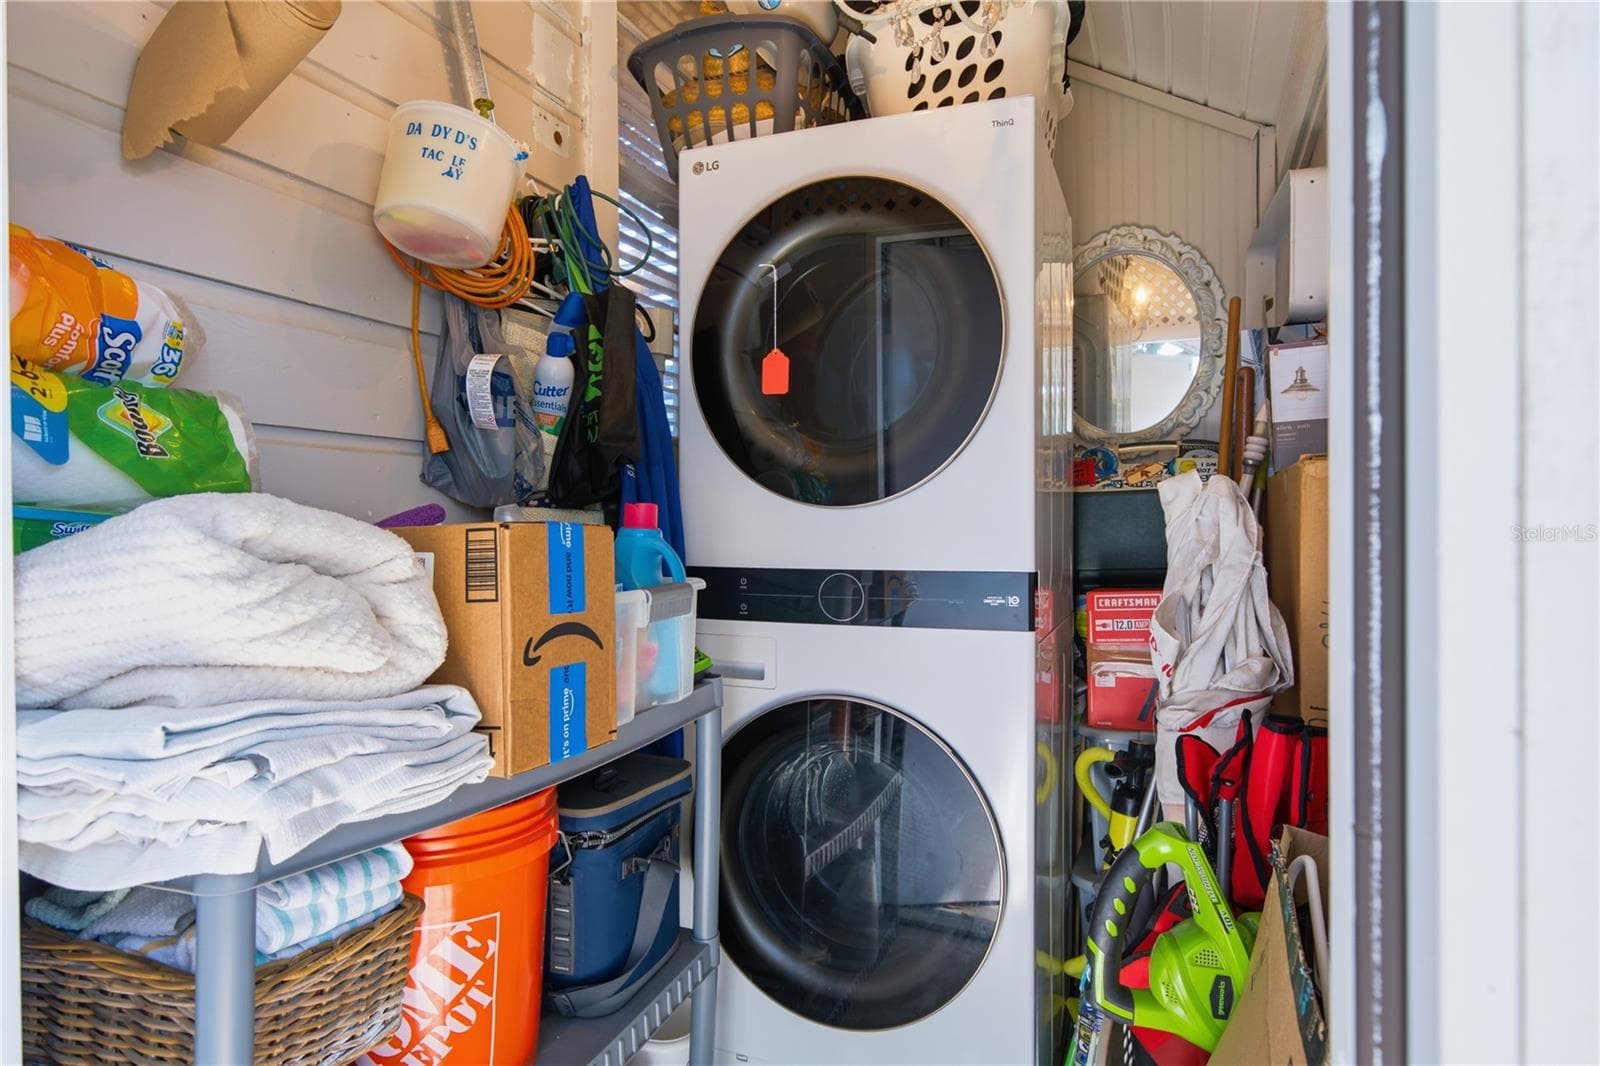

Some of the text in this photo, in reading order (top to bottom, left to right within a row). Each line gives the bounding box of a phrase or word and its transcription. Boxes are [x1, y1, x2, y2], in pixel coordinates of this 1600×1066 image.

[991, 118, 1015, 128] ThinQ
[421, 146, 445, 162] TAC
[706, 160, 720, 171] LG
[93, 325, 137, 386] Scott
[151, 343, 182, 378] 36
[534, 380, 570, 397] Cutter
[113, 385, 170, 458] Bounty
[1098, 597, 1158, 608] CRAFTSMAN
[1115, 620, 1133, 630] 12.0
[562, 688, 571, 721] prime
[563, 722, 571, 738] on
